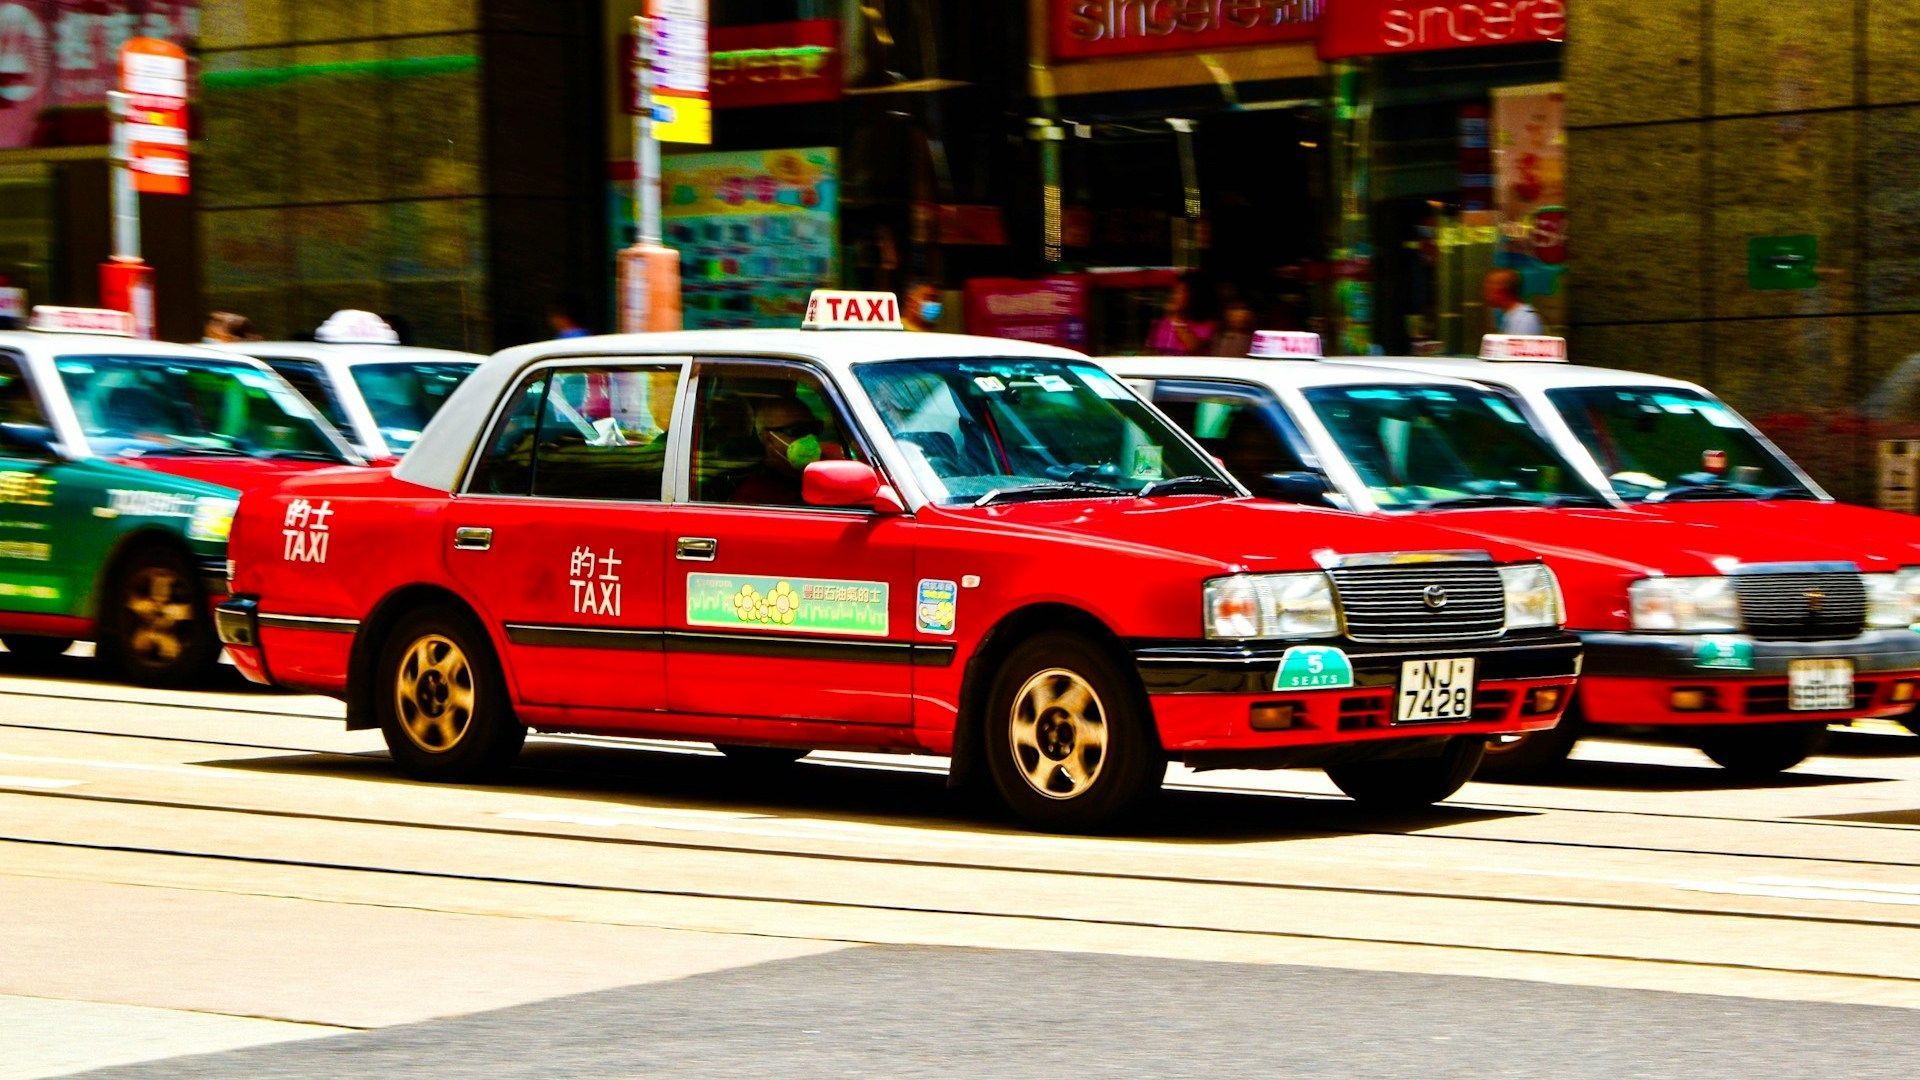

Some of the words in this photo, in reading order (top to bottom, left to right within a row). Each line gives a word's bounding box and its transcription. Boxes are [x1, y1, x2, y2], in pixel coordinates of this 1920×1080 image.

[1066, 0, 1261, 41] sincere
[826, 298, 895, 321] TAXI
[284, 498, 334, 530] 的士
[282, 529, 329, 563] TAXI
[570, 545, 622, 581] 的士
[569, 579, 621, 617] TAXI
[1307, 654, 1324, 674] 5
[1422, 661, 1454, 690] NJ
[1291, 674, 1338, 686] SEATS
[1405, 687, 1466, 718] 7428
